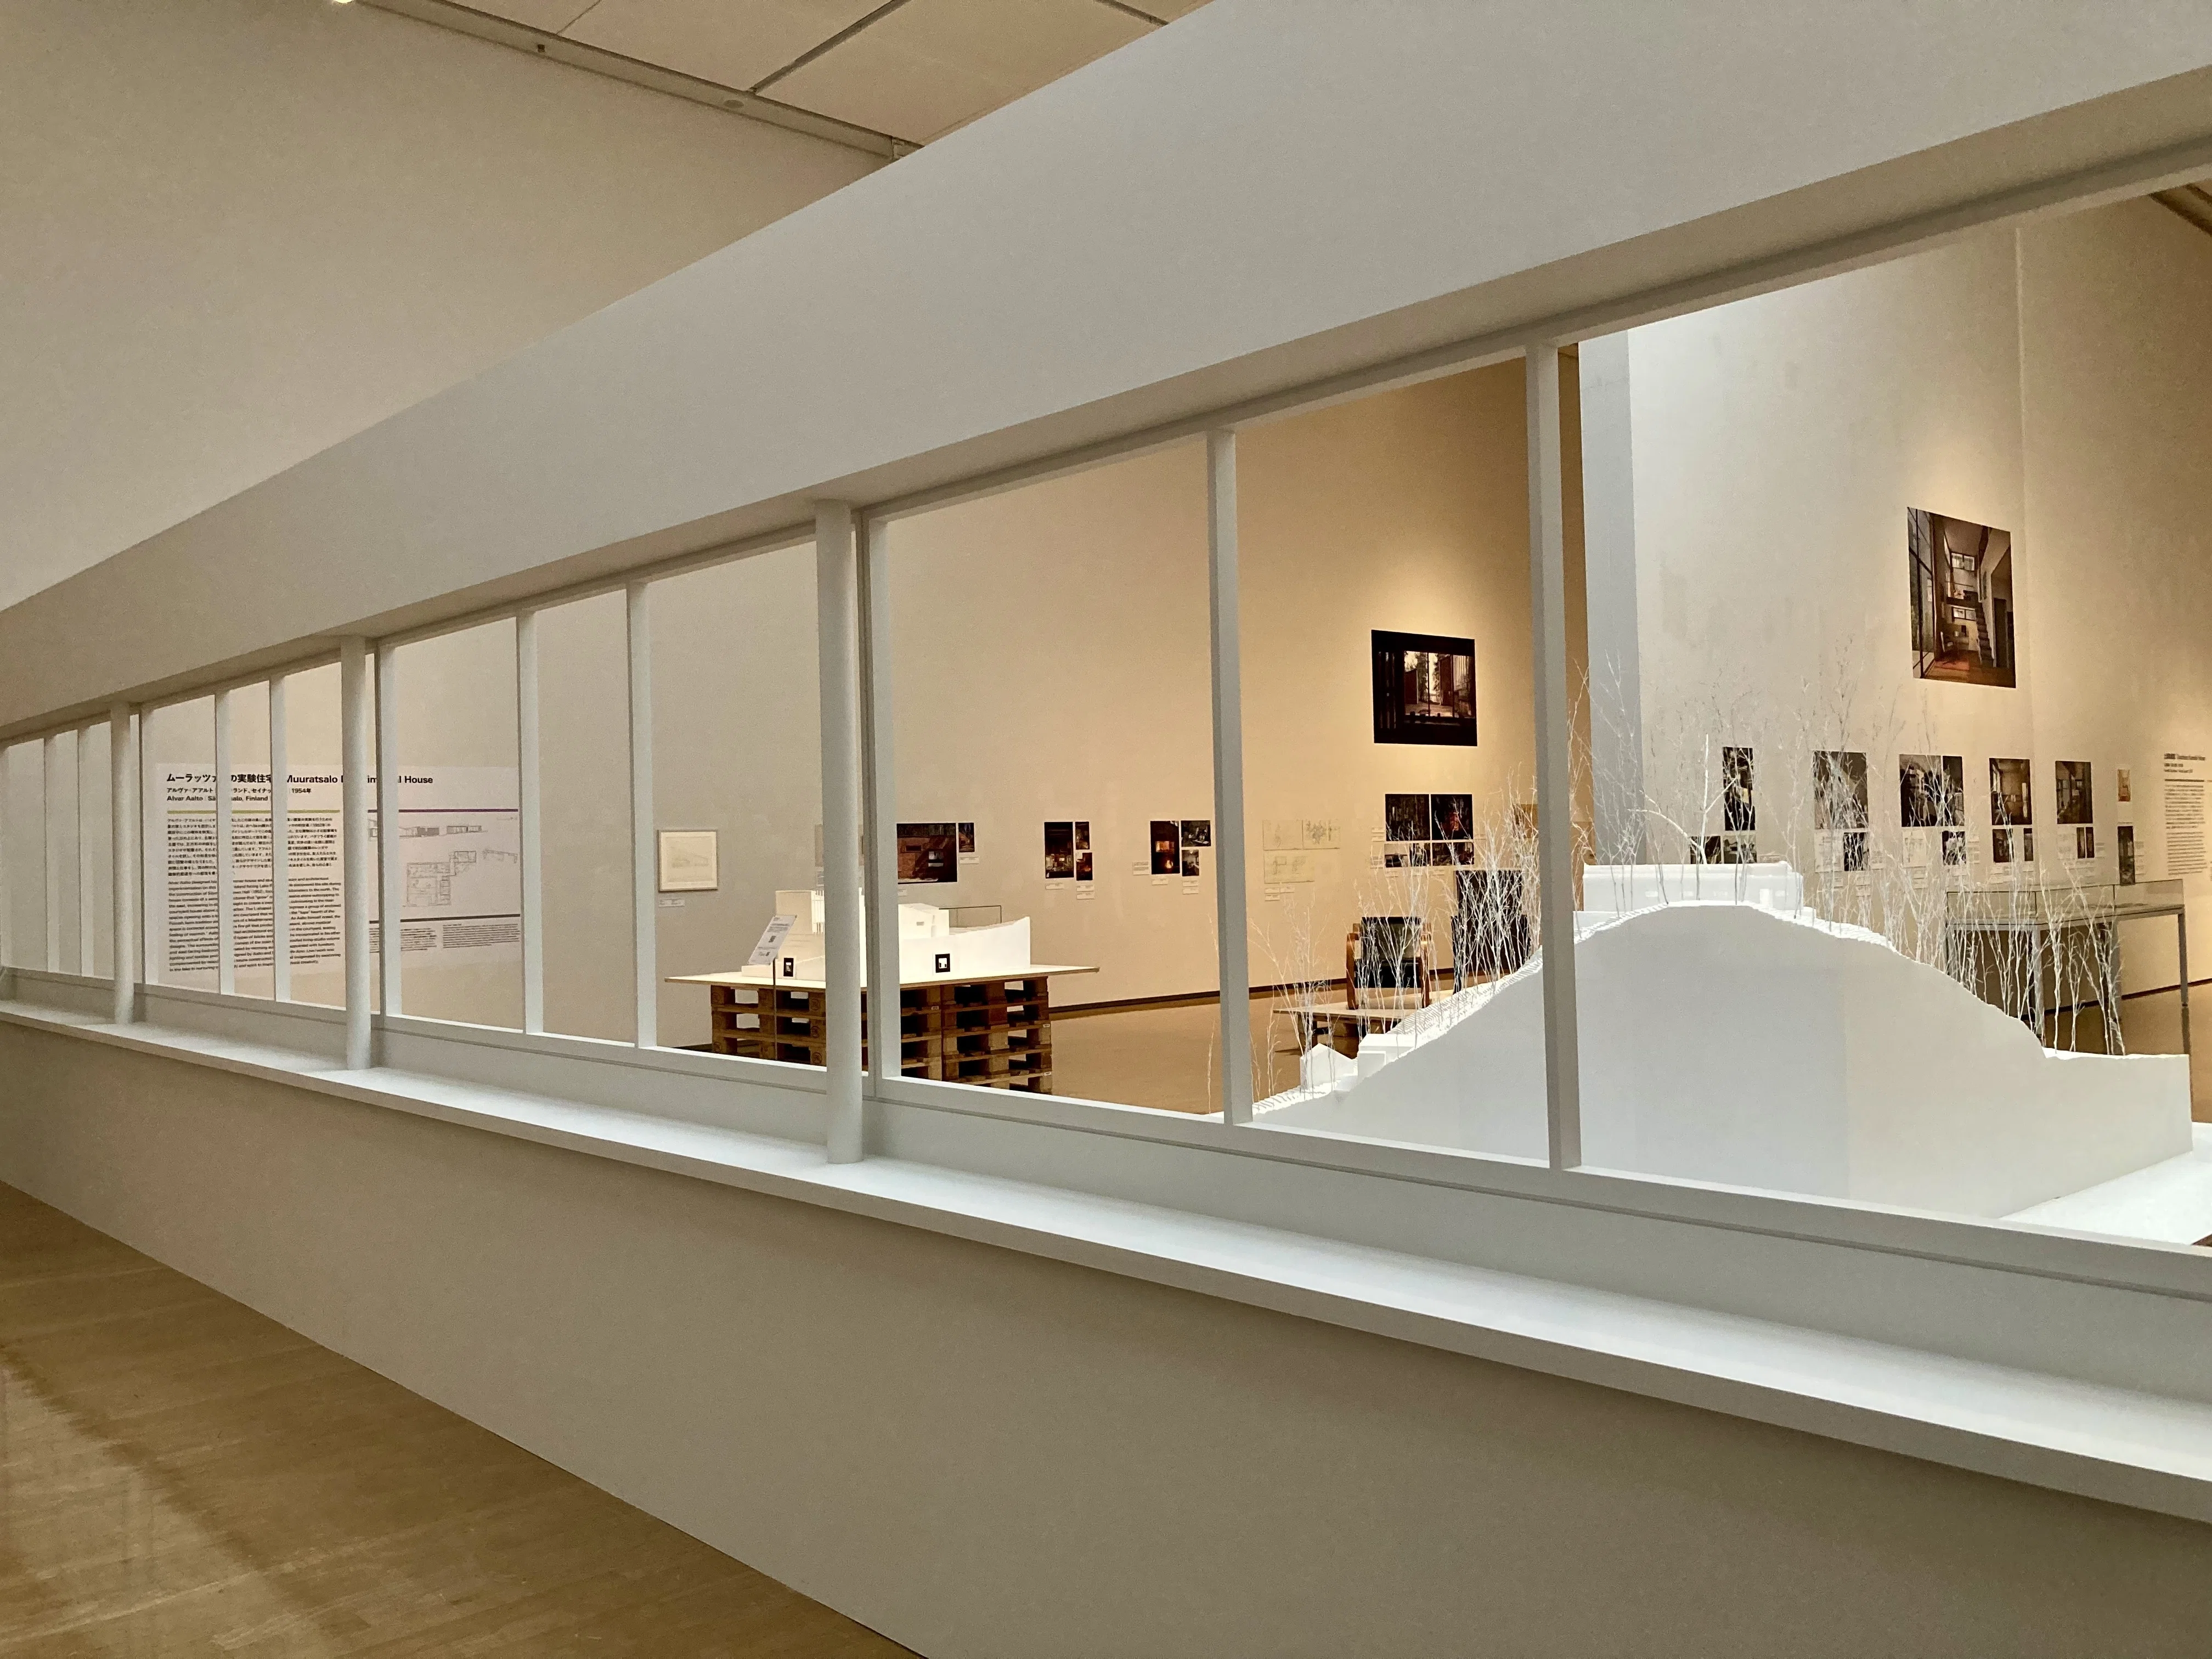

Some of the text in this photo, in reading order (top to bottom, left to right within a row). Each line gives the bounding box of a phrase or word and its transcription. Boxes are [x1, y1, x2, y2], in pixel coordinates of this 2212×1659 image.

[166, 774, 272, 783] ムーラッツァの実験住宅
[286, 775, 338, 783] Muuratsalo
[404, 775, 433, 783] House
